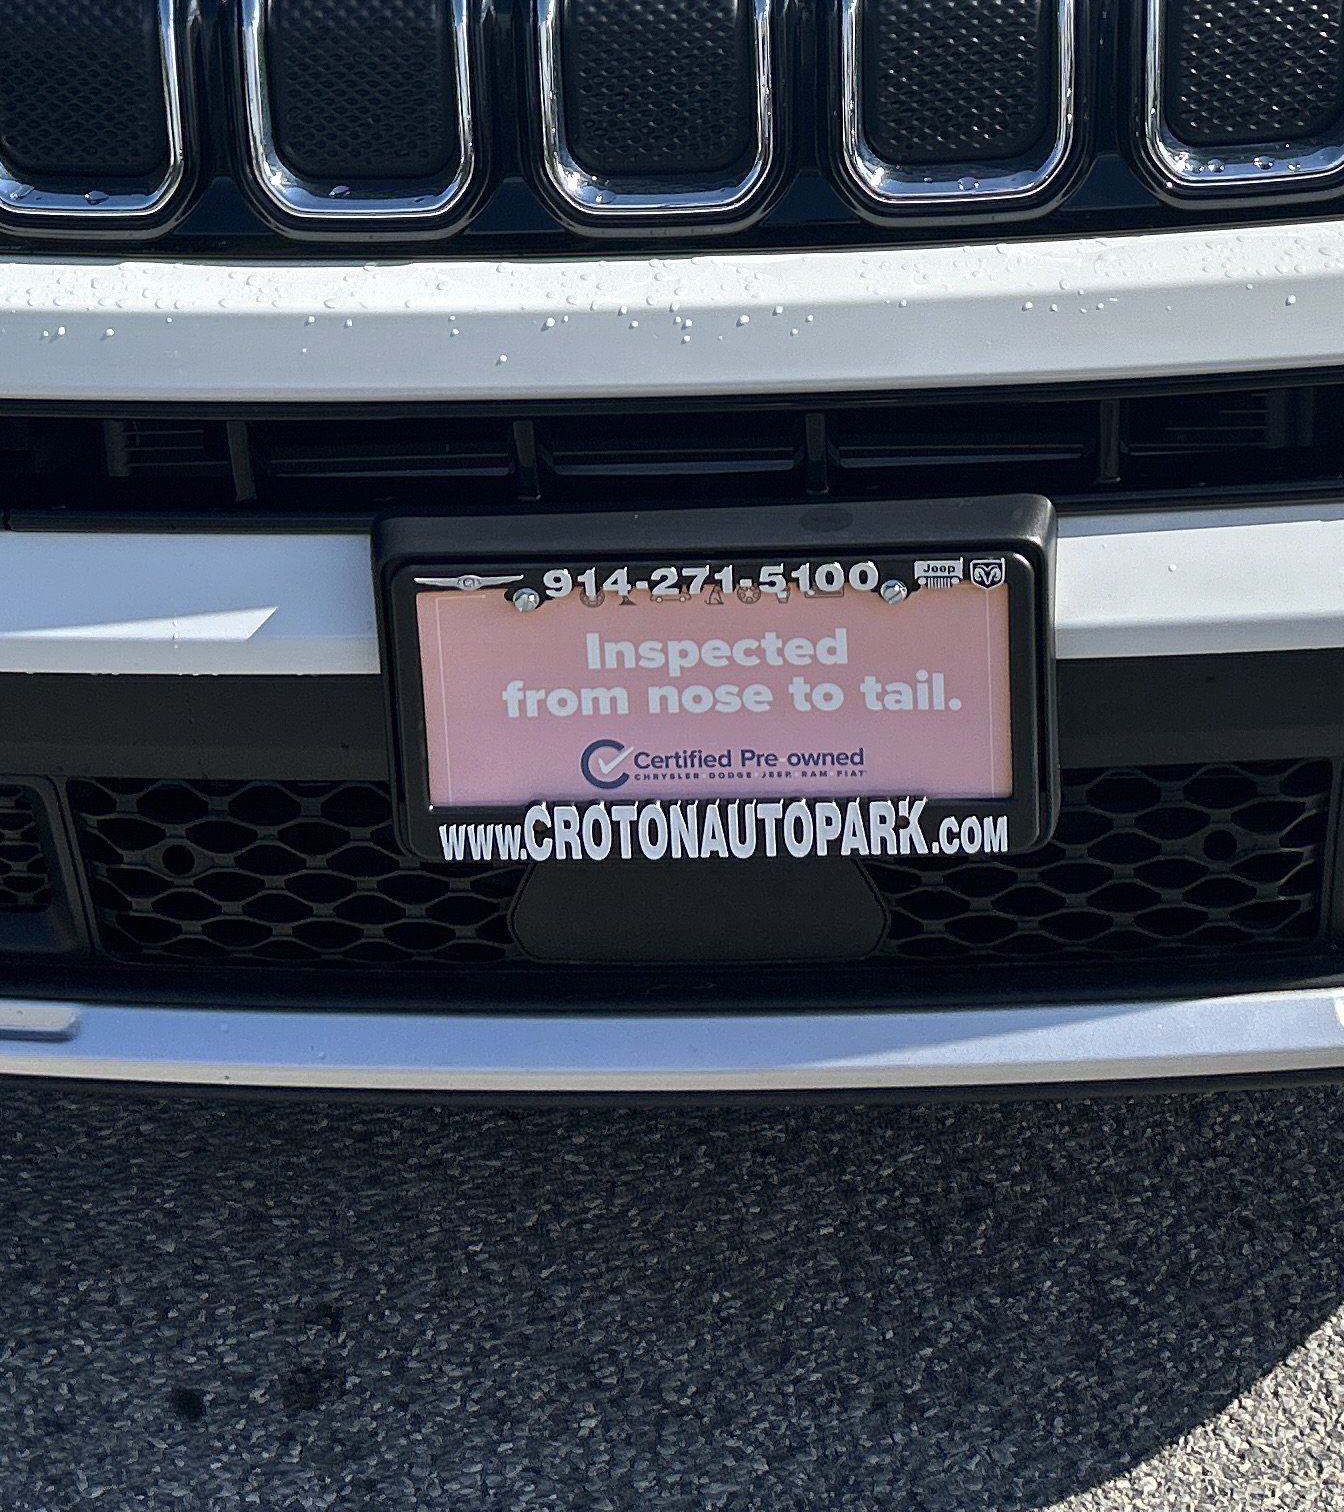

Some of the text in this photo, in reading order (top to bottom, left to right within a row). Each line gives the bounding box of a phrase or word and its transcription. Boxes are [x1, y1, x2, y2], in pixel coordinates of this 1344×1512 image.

[542, 561, 879, 600] 914-271-5100
[585, 628, 849, 677] Inspected
[502, 670, 962, 718] from nose to tail.
[633, 748, 732, 770] Certified
[634, 769, 865, 781] CHRYSLER DODGE JEEP RAM FIAT
